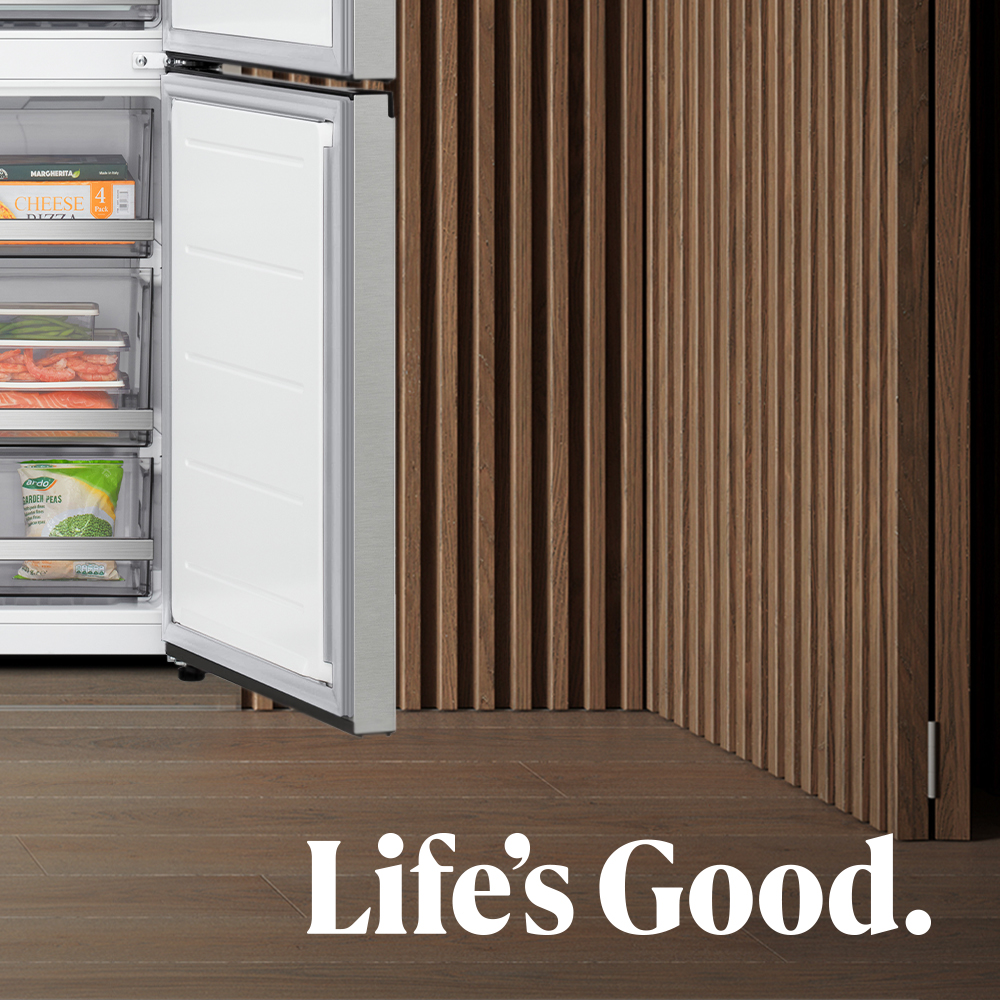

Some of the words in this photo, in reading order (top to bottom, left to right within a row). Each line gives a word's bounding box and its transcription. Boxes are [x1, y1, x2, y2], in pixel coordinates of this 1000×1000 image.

[30, 170, 73, 178] MARGHERITA
[94, 187, 106, 204] 4
[14, 196, 85, 212] CHEESE
[26, 479, 50, 487] ardo
[46, 494, 63, 504] PEAS
